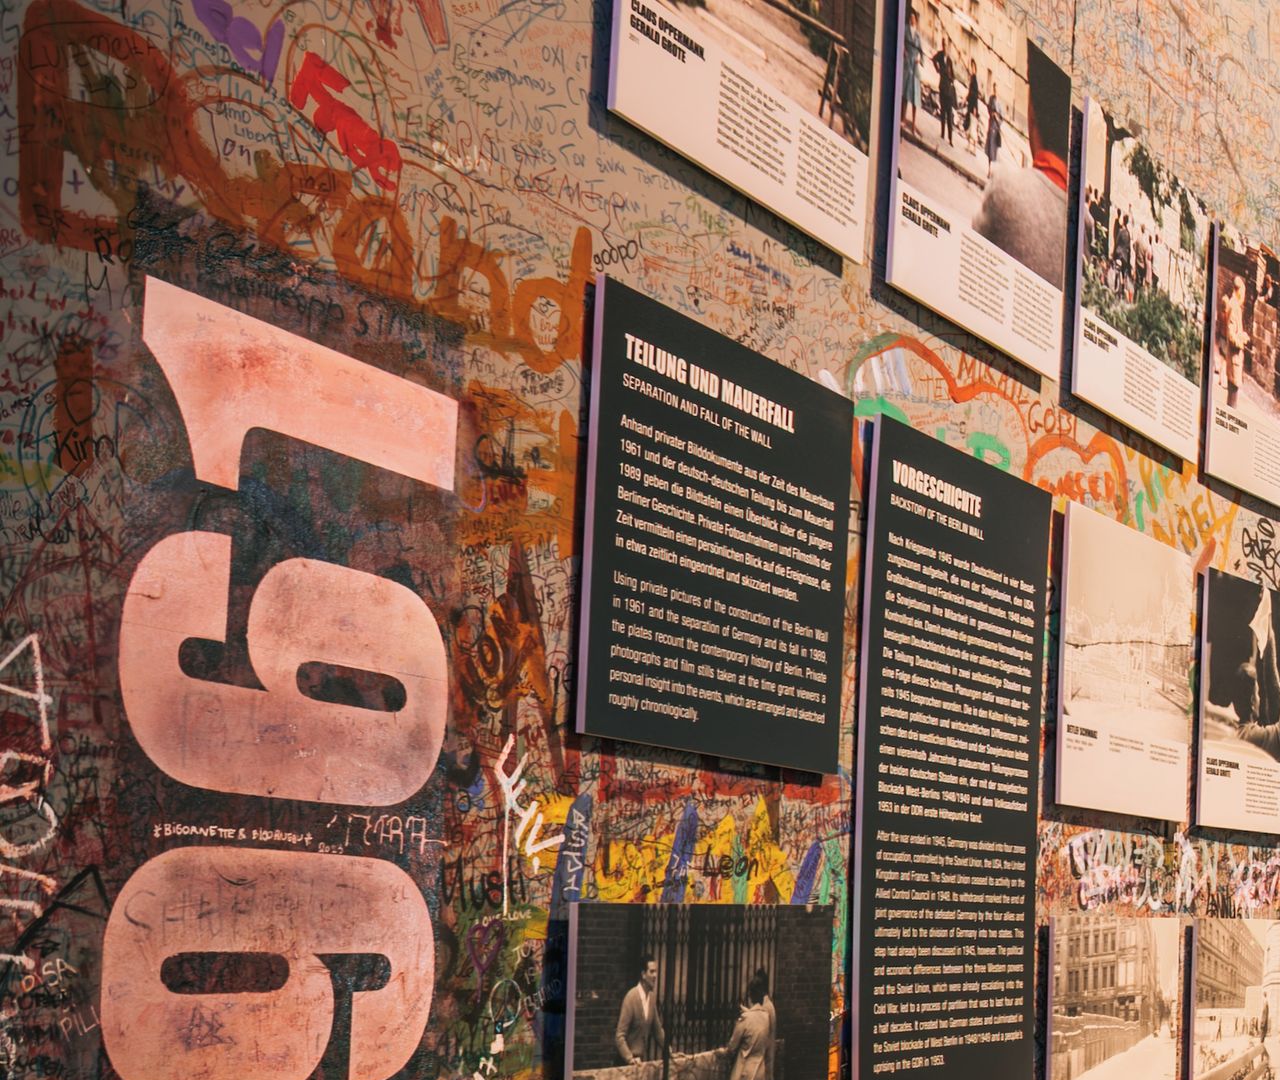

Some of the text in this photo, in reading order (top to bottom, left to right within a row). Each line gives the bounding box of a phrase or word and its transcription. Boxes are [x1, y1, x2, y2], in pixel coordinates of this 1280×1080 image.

[630, 14, 686, 64] GERALD GROTE
[631, 0, 657, 24] CLAUS
[623, 373, 772, 449] SEPARATION AND FALL OF THE WALL
[625, 333, 794, 434] TEILUNG UND MAUERFALL
[620, 414, 653, 438] Anhand
[655, 430, 686, 451] privater
[744, 467, 757, 480] aus
[759, 471, 771, 485] der
[771, 475, 785, 491] Zeit
[786, 482, 798, 496] des
[621, 439, 641, 457] 1961
[645, 450, 660, 464] und
[662, 455, 676, 470] der
[678, 462, 751, 499] deutsch-deutschen
[750, 488, 775, 511] Teilung
[776, 499, 787, 513] bis
[788, 506, 803, 519] zum
[892, 459, 981, 518] VORGESCHICHTE
[618, 485, 651, 508] Berliner
[652, 498, 697, 524] Geschichte.
[696, 514, 724, 534] Private
[778, 545, 793, 557] und
[820, 558, 832, 571] der
[620, 463, 833, 551] 1989 geben die Bildtafeln einen Überblick über die jüngere
[890, 493, 984, 541] BACKSTORY OF THE BERLIN WALL
[616, 509, 633, 526] Zeit
[632, 518, 675, 540] vermitteln
[676, 531, 697, 547] einen
[745, 553, 763, 569] Blick
[762, 561, 776, 573] auf
[775, 564, 787, 577] die
[821, 579, 831, 591] die
[616, 533, 624, 547] in
[626, 539, 647, 555] etwa
[648, 547, 677, 564] zeitlich
[679, 555, 725, 579] eingeordnet
[726, 571, 740, 584] und
[741, 575, 771, 593] skizziert
[613, 595, 621, 608] in
[625, 598, 644, 614] 1961
[649, 607, 664, 619] and
[666, 610, 679, 623] the
[681, 616, 720, 634] separation
[722, 625, 730, 636] of
[732, 627, 762, 648] Germany
[764, 638, 777, 649] and
[801, 646, 807, 657] in
[614, 570, 637, 591] Using
[640, 581, 668, 597] private
[671, 588, 701, 607] pictures
[704, 598, 712, 609] of
[714, 600, 726, 614] the
[728, 606, 771, 626] construction
[773, 618, 780, 628] of
[782, 620, 793, 632] the
[794, 623, 813, 638] Berlin
[612, 619, 625, 633] the
[628, 624, 652, 640] plates
[655, 632, 684, 648] recount
[687, 638, 699, 652] the
[701, 644, 749, 666] contemporary
[751, 654, 773, 672] history
[775, 661, 782, 672] of
[806, 667, 827, 683] Private
